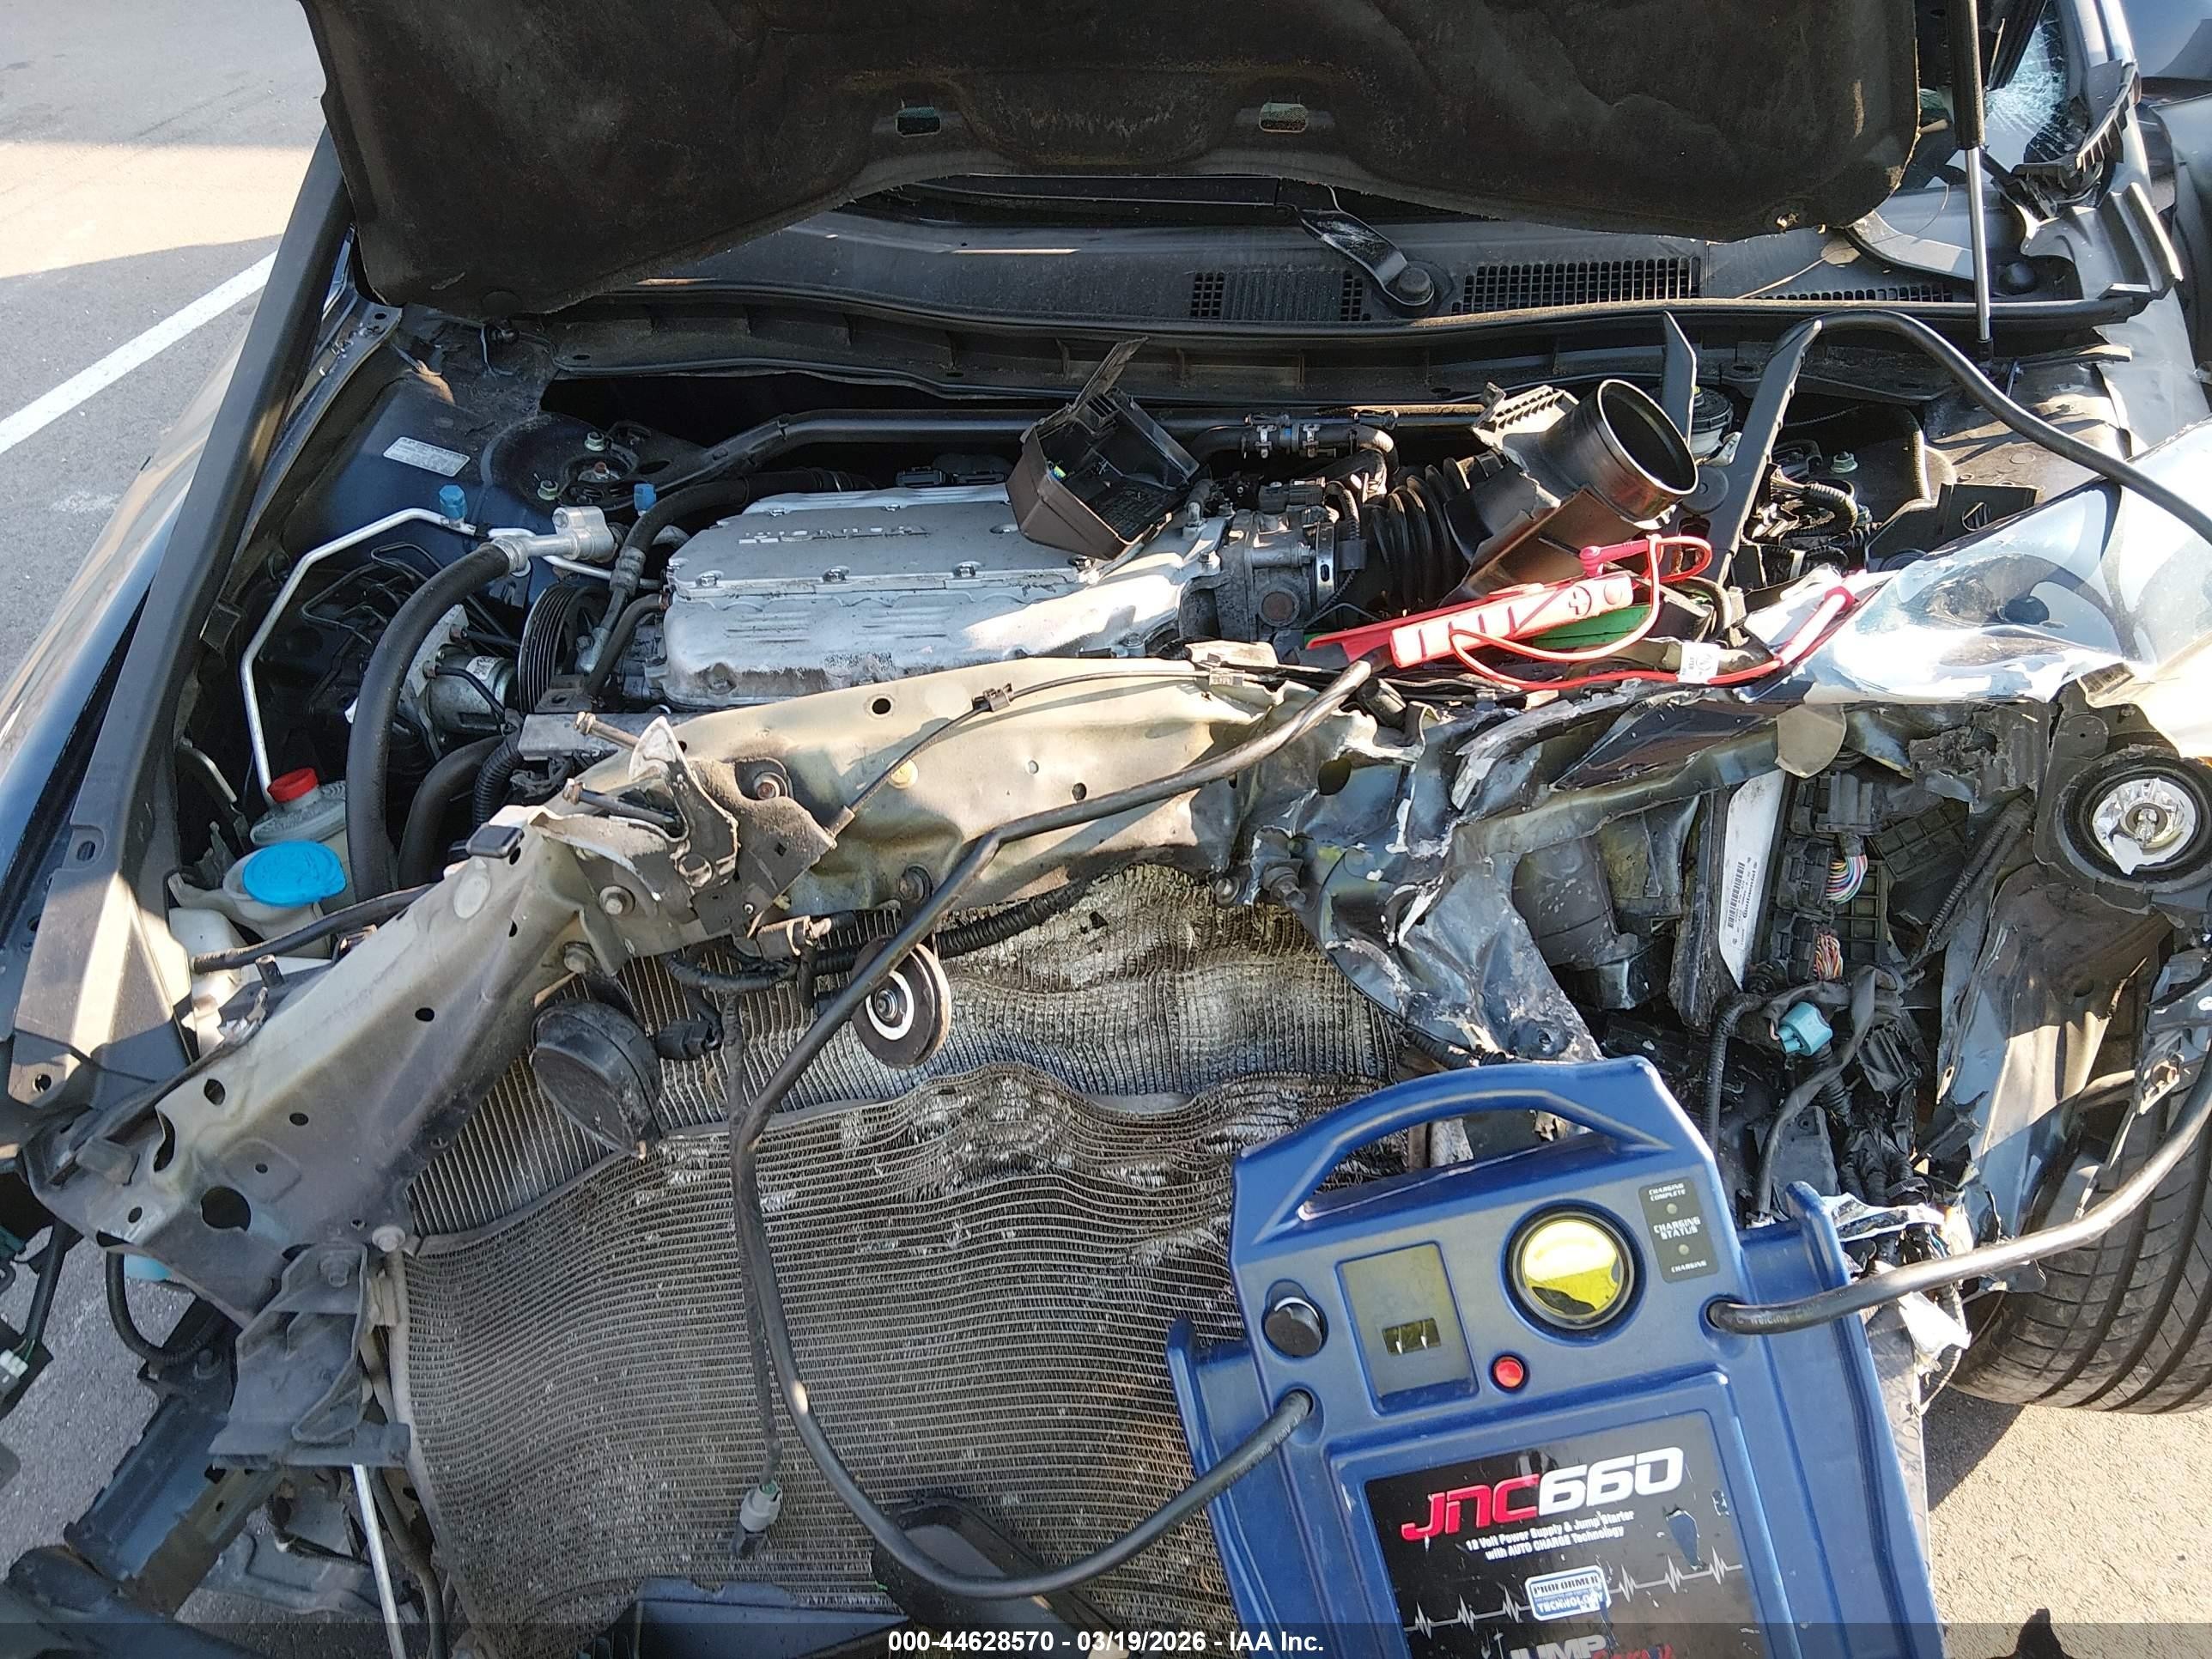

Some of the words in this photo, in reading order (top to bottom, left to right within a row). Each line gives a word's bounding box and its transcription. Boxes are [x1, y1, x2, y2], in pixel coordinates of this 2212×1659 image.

[1649, 1182, 1684, 1196] CHARGING
[1650, 1188, 1686, 1201] COMPLETE
[1653, 1216, 1701, 1234] CHARGING
[1660, 1225, 1698, 1240] STATUS
[1671, 1260, 1707, 1273] CHARGING
[1401, 1447, 1684, 1541] JNC660
[1466, 1540, 1480, 1552] 12
[1479, 1535, 1499, 1548] Volt
[1498, 1531, 1529, 1545] Power
[1529, 1524, 1563, 1539] Supply
[1564, 1521, 1573, 1533] &
[1573, 1516, 1601, 1530] Jump
[1601, 1510, 1635, 1524] Starter
[1485, 1547, 1507, 1560] with
[1508, 1543, 1533, 1557] AUTO
[1534, 1534, 1572, 1552] CHARGE
[1571, 1525, 1625, 1543] Technology
